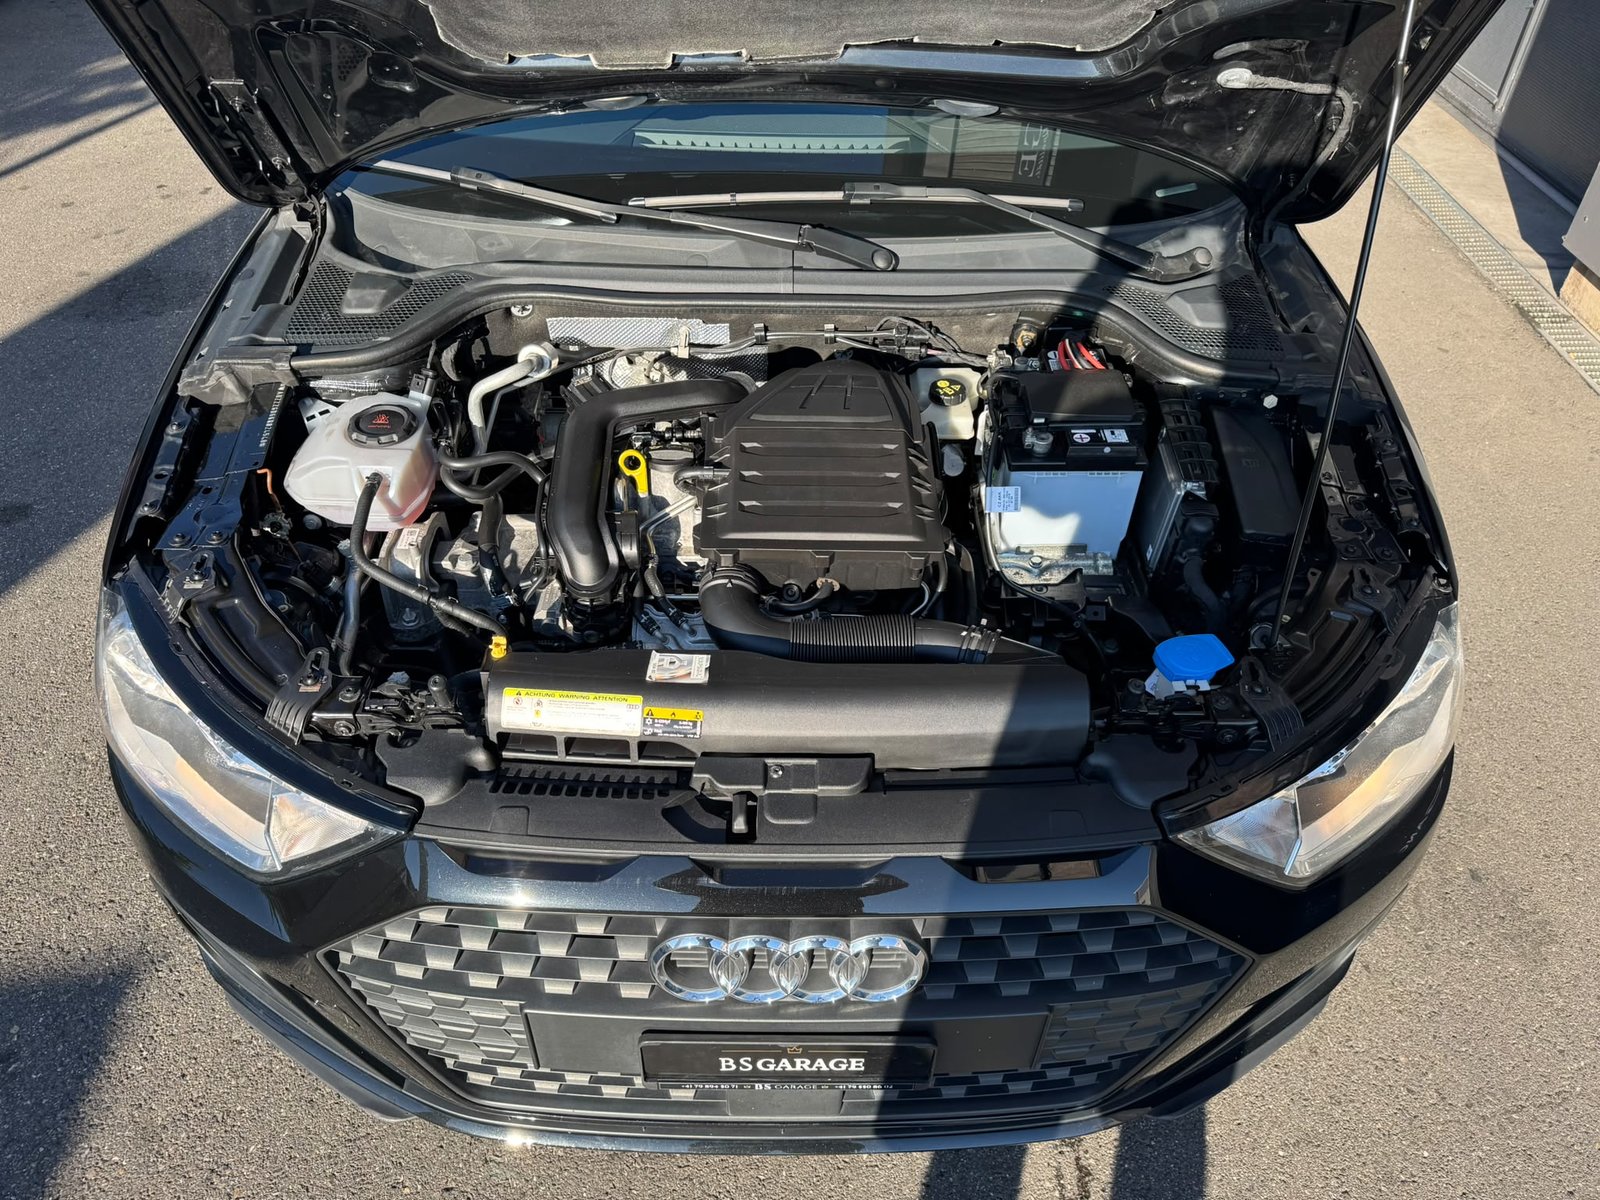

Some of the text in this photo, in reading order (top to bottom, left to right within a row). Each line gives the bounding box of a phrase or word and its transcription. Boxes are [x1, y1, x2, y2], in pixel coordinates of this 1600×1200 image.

[524, 691, 556, 699] ACHTUNG
[558, 693, 590, 701] WARNING
[719, 1057, 865, 1071] BS GARAGE
